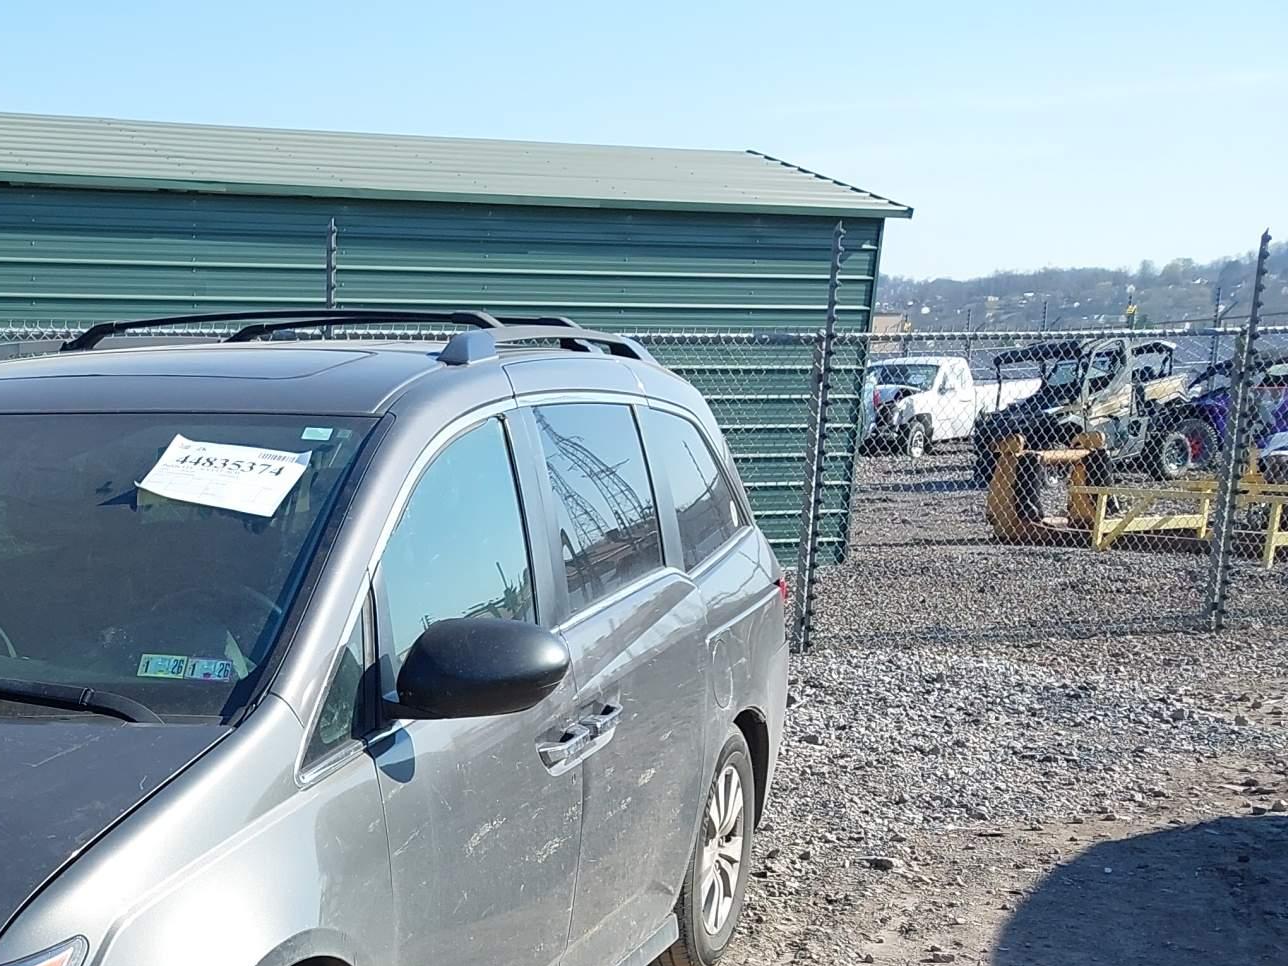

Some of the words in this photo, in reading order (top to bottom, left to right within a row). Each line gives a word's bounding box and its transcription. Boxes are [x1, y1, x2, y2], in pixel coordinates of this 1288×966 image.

[175, 453, 285, 477] 44835374
[143, 660, 150, 673] 1
[171, 659, 184, 675] 26
[217, 662, 231, 678] 26
